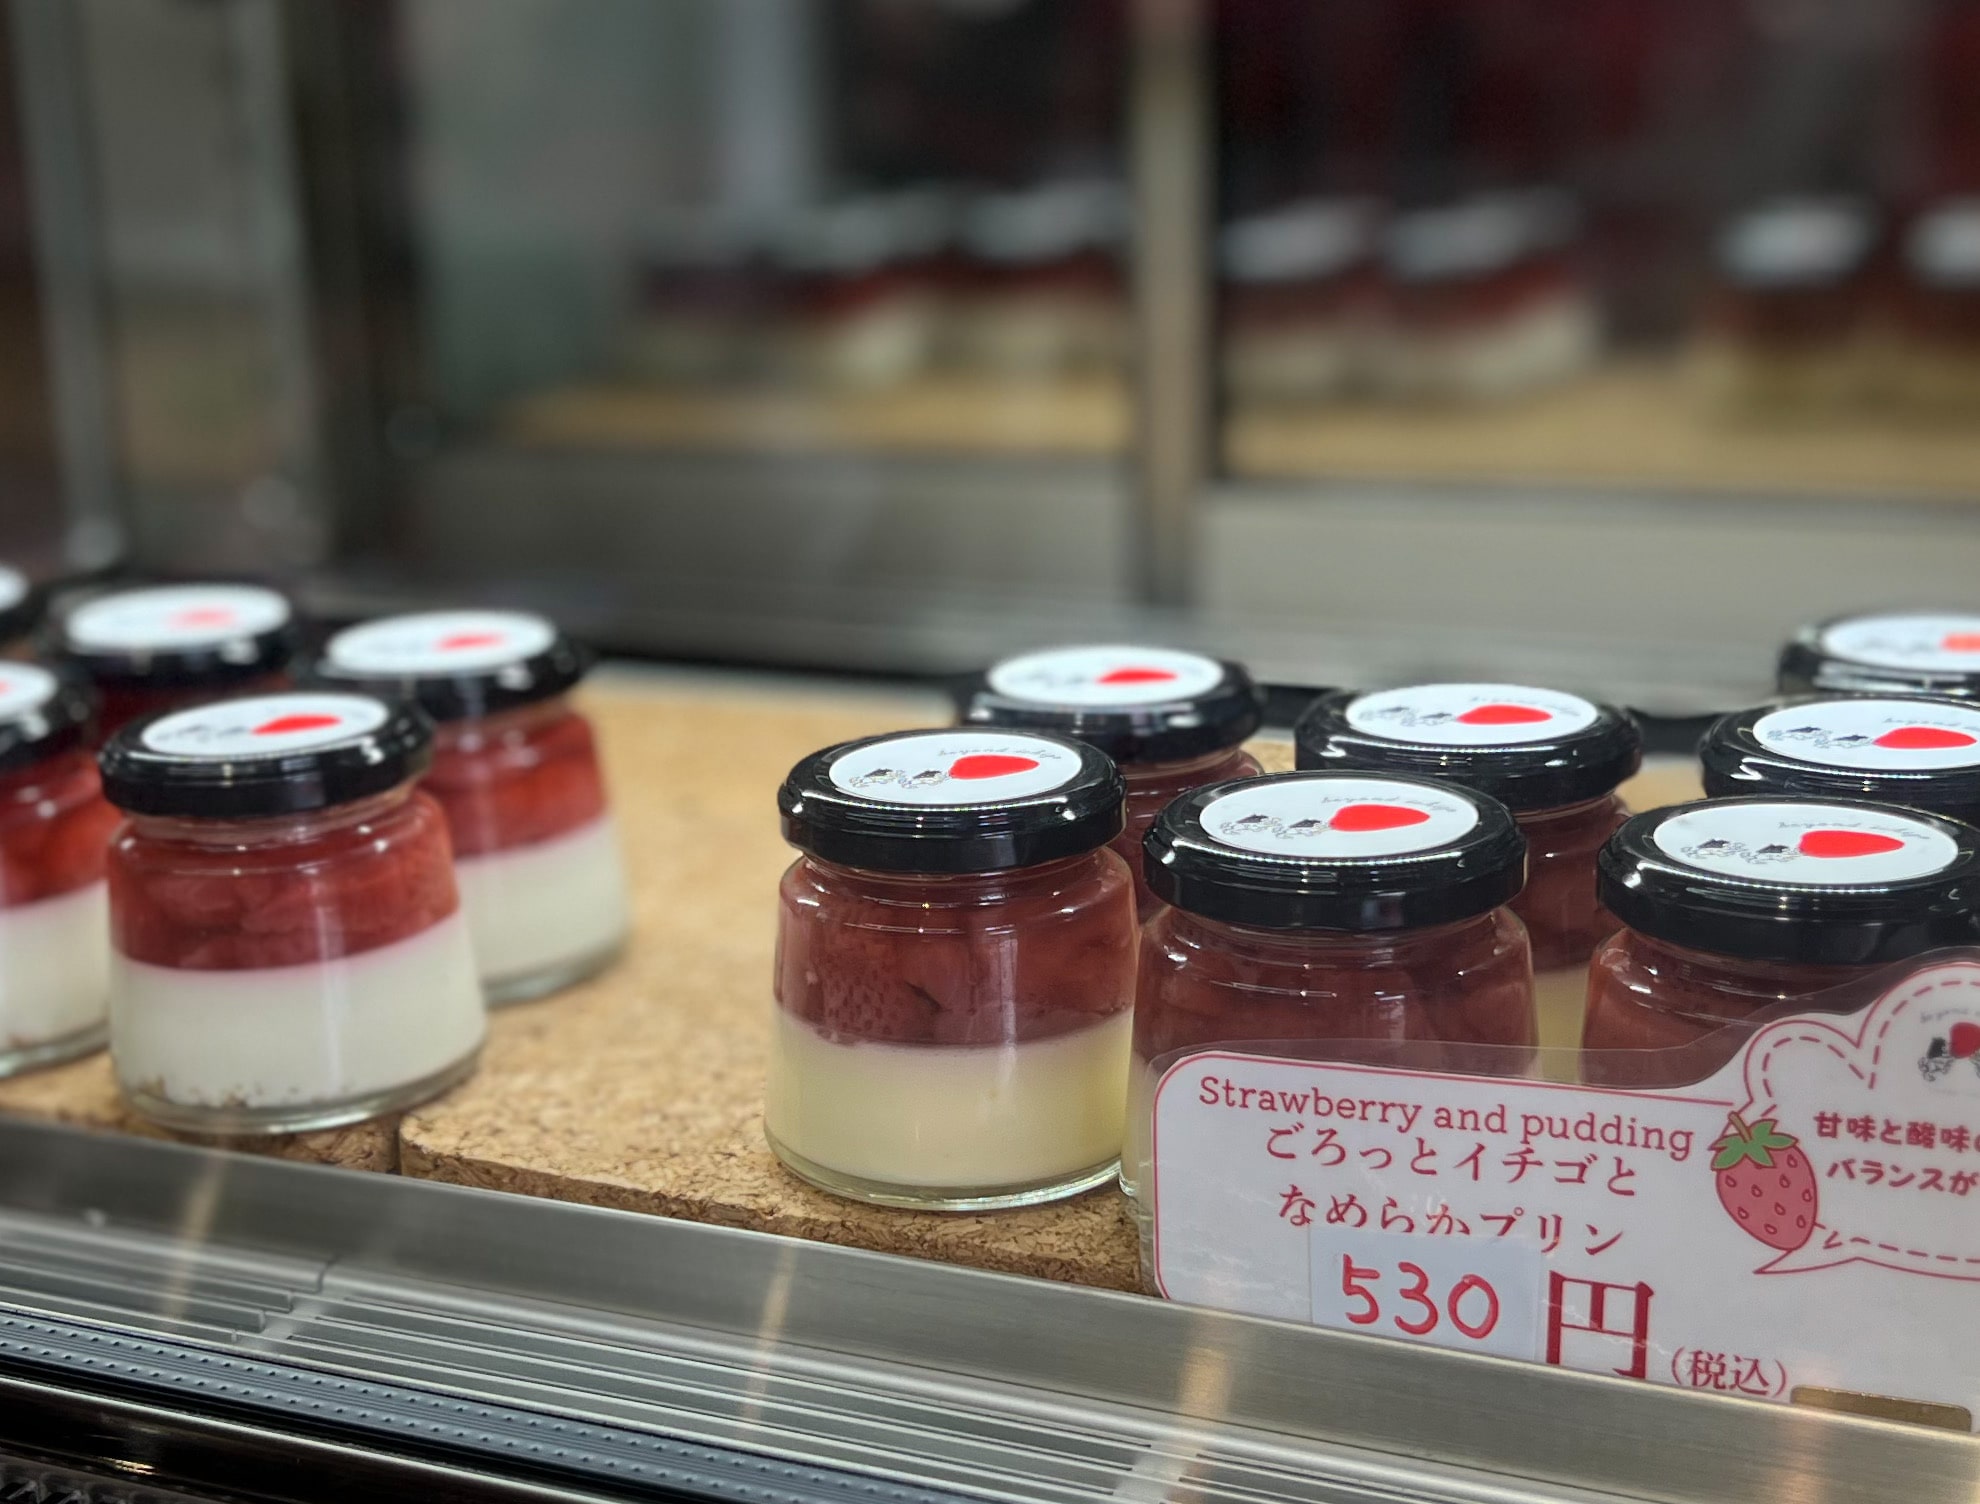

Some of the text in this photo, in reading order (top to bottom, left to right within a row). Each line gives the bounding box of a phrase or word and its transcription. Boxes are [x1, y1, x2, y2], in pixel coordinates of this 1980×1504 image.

[1199, 1076, 1694, 1162] Strawberry and pudding
[1813, 1110, 1980, 1154] 甘味と酸味
[1266, 1121, 1636, 1197] ごろっとイチゴと
[1826, 1157, 1978, 1197] バランスが
[1278, 1183, 1624, 1256] なめらかプリン
[1342, 1253, 1787, 1398] 530 円 (税込)
